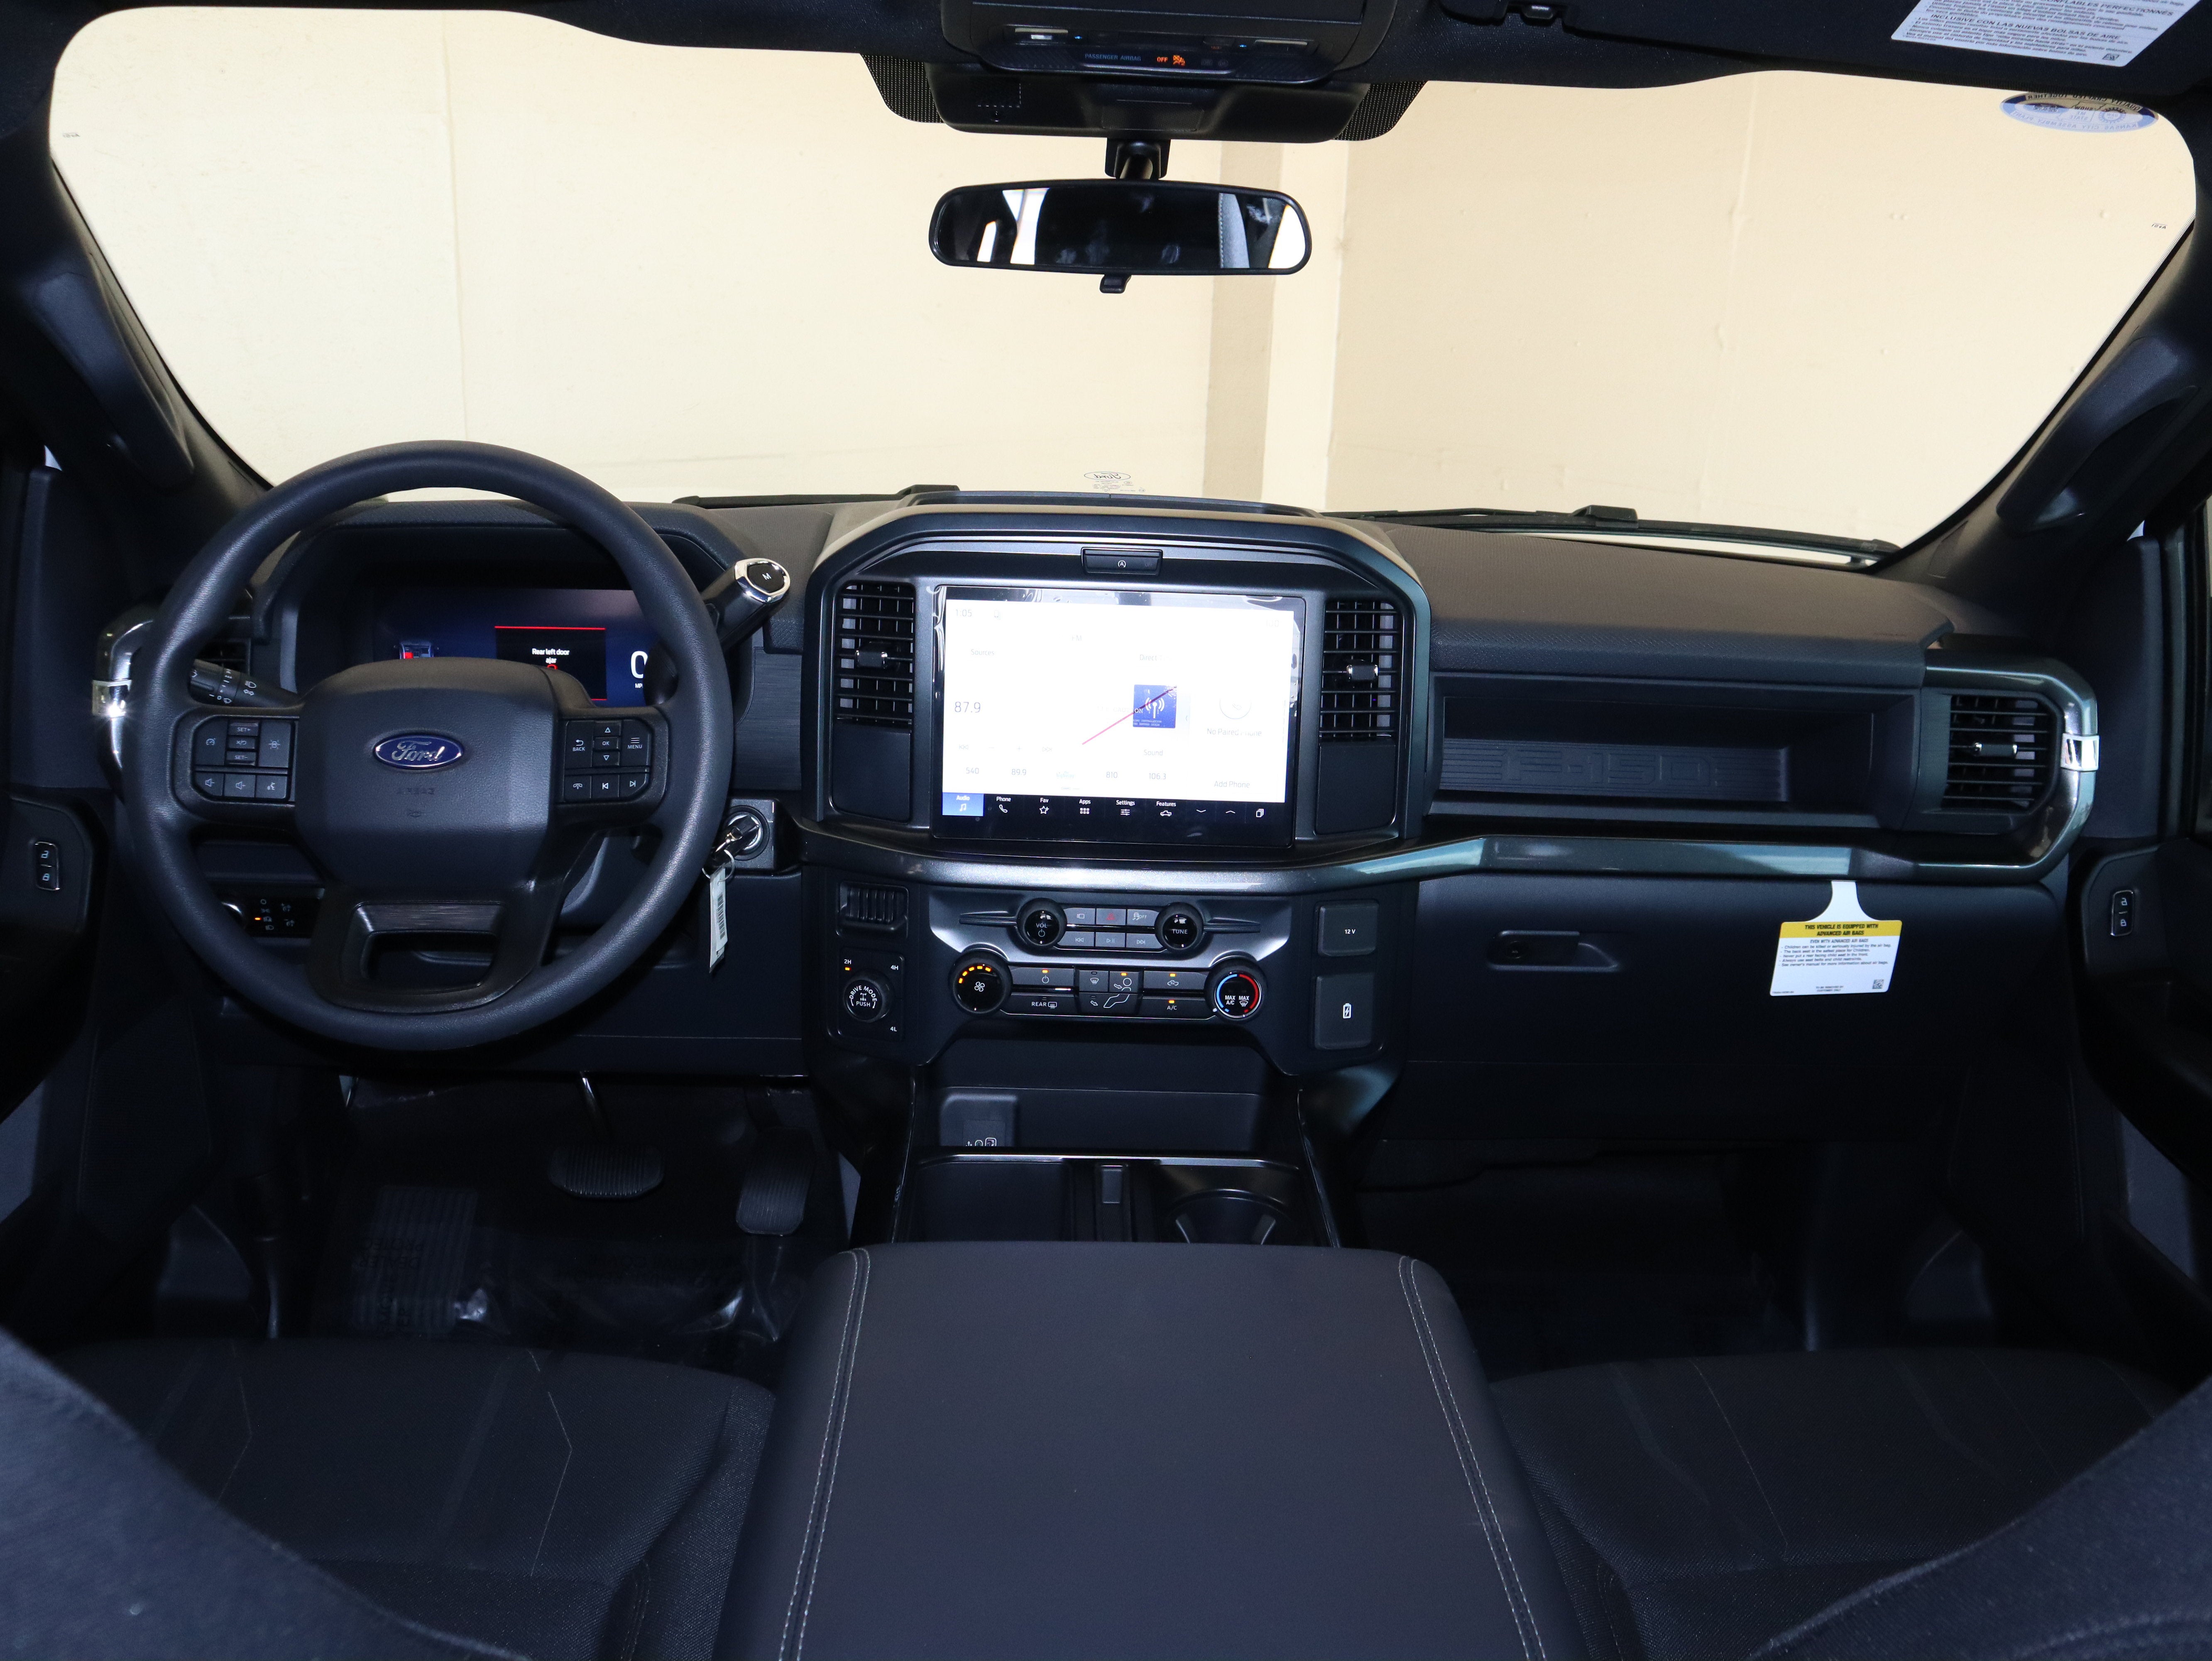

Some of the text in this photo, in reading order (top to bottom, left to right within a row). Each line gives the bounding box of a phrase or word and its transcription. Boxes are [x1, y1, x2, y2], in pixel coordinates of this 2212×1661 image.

[955, 702, 981, 713] 87.9
[392, 740, 445, 761] Ford
[1501, 749, 1715, 786] F-150
[849, 985, 877, 1002] DRIVE MODE
